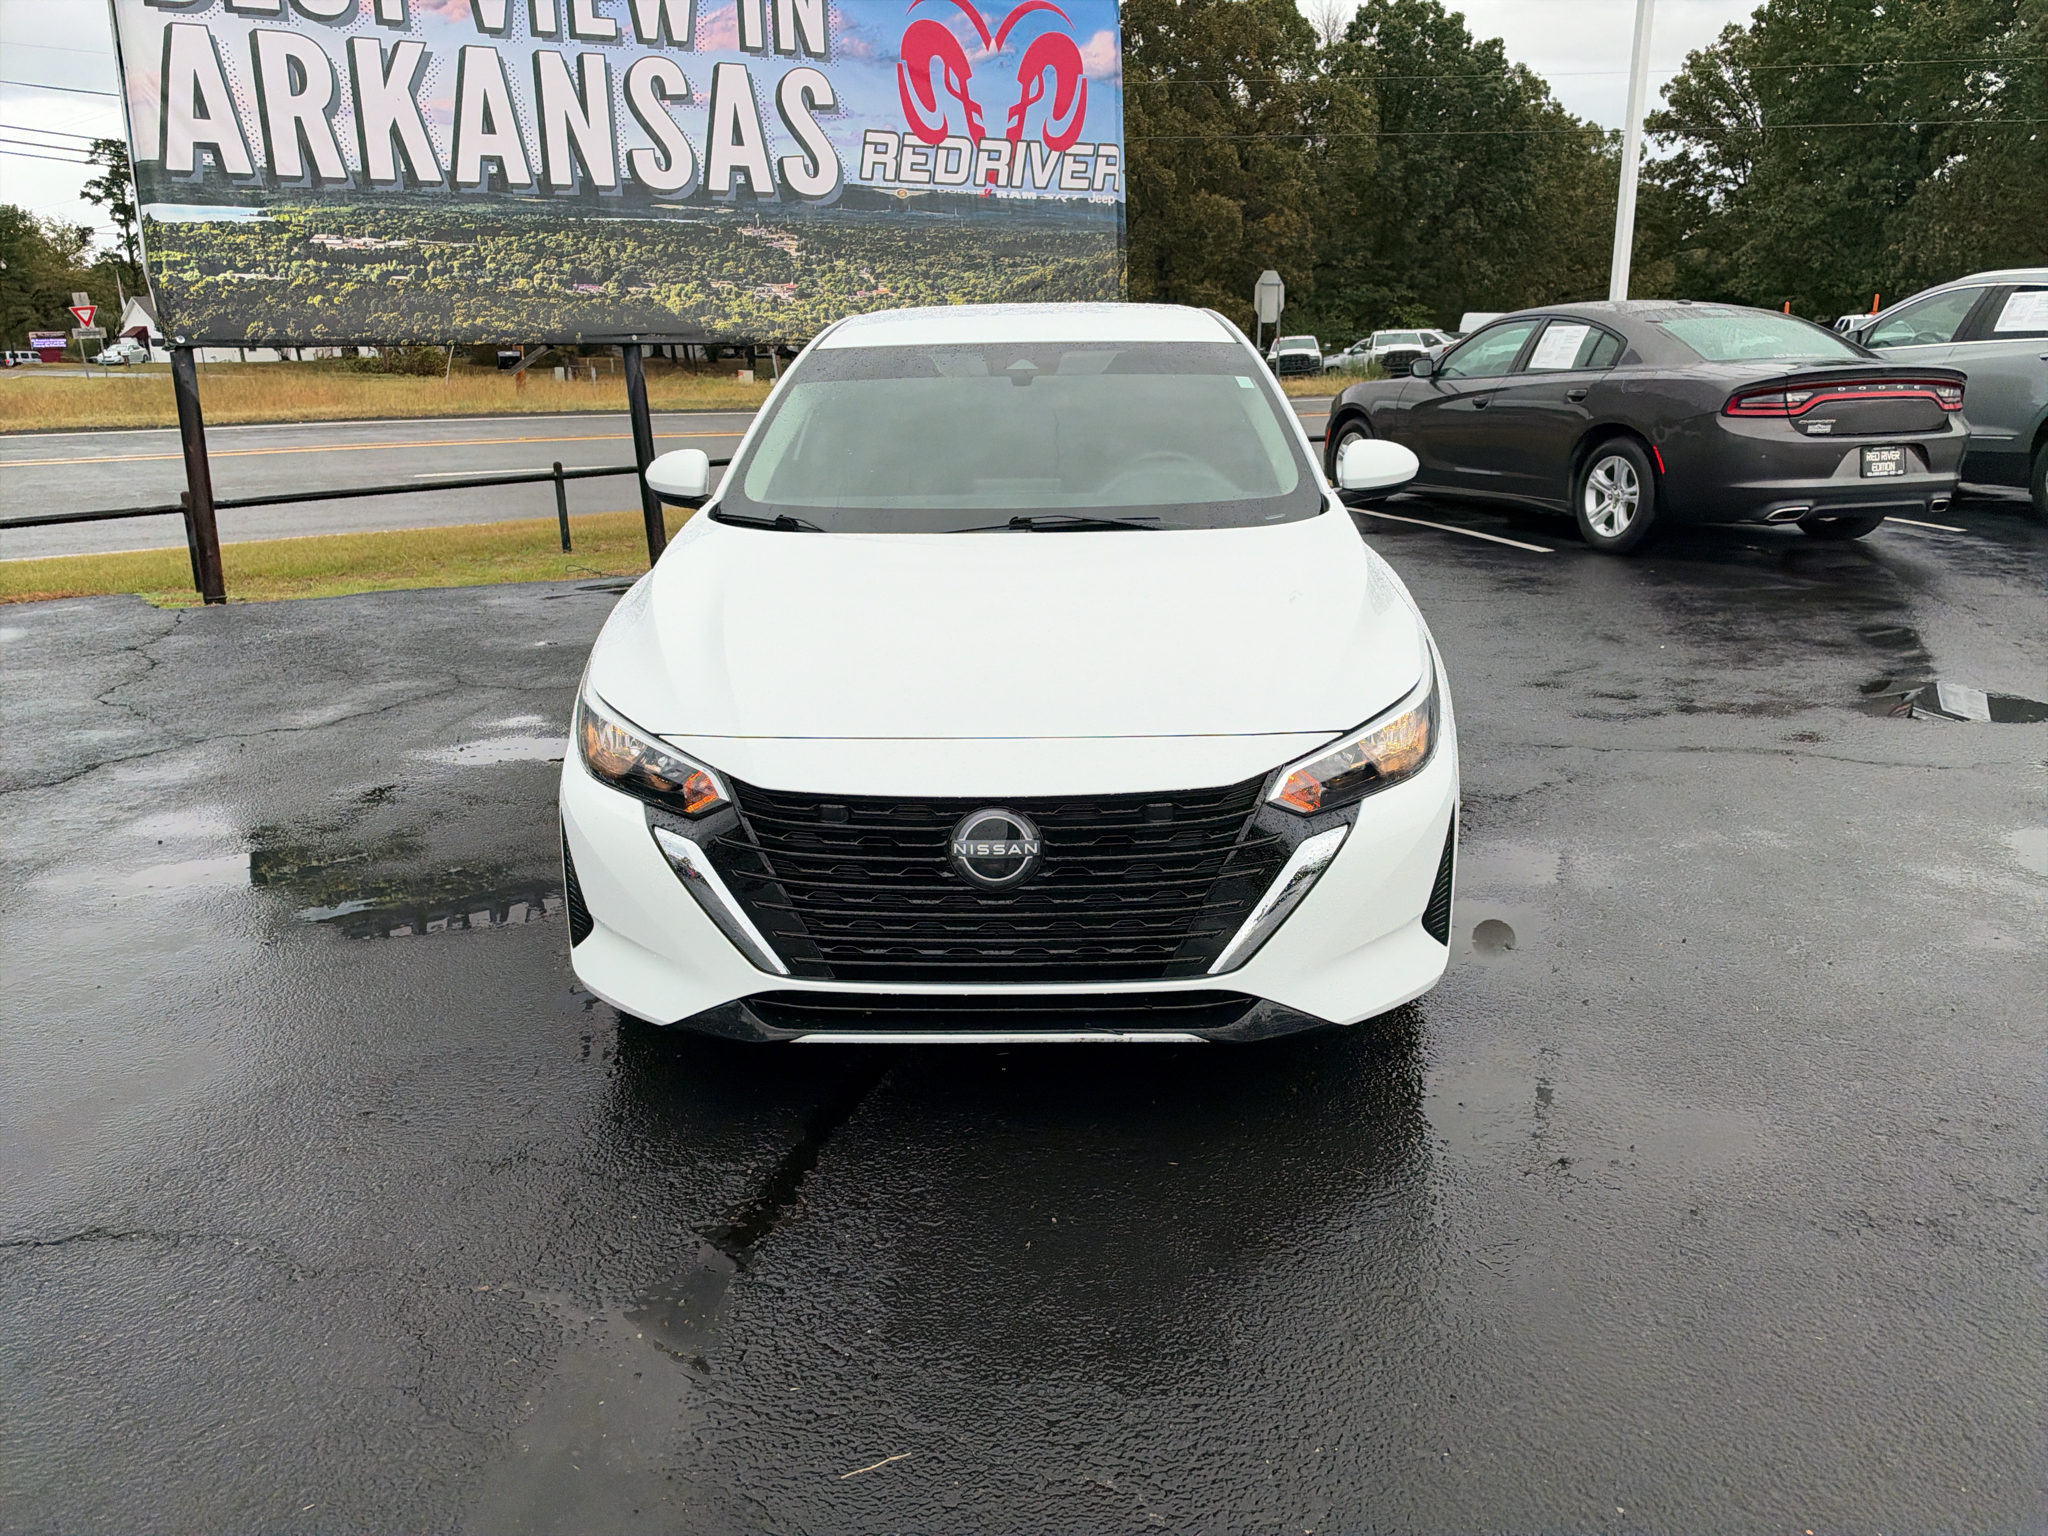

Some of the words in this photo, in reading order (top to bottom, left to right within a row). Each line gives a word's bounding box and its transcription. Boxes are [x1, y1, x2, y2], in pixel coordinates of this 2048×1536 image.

[163, 22, 842, 198] ARKANSAS
[996, 190, 1037, 200] RAM
[1040, 193, 1083, 203] SRT
[1088, 192, 1116, 206] Jeep
[1866, 451, 1880, 462] RED
[1880, 450, 1901, 461] RIVER
[1871, 461, 1896, 472] EDITION
[953, 842, 1038, 855] NISSAN
